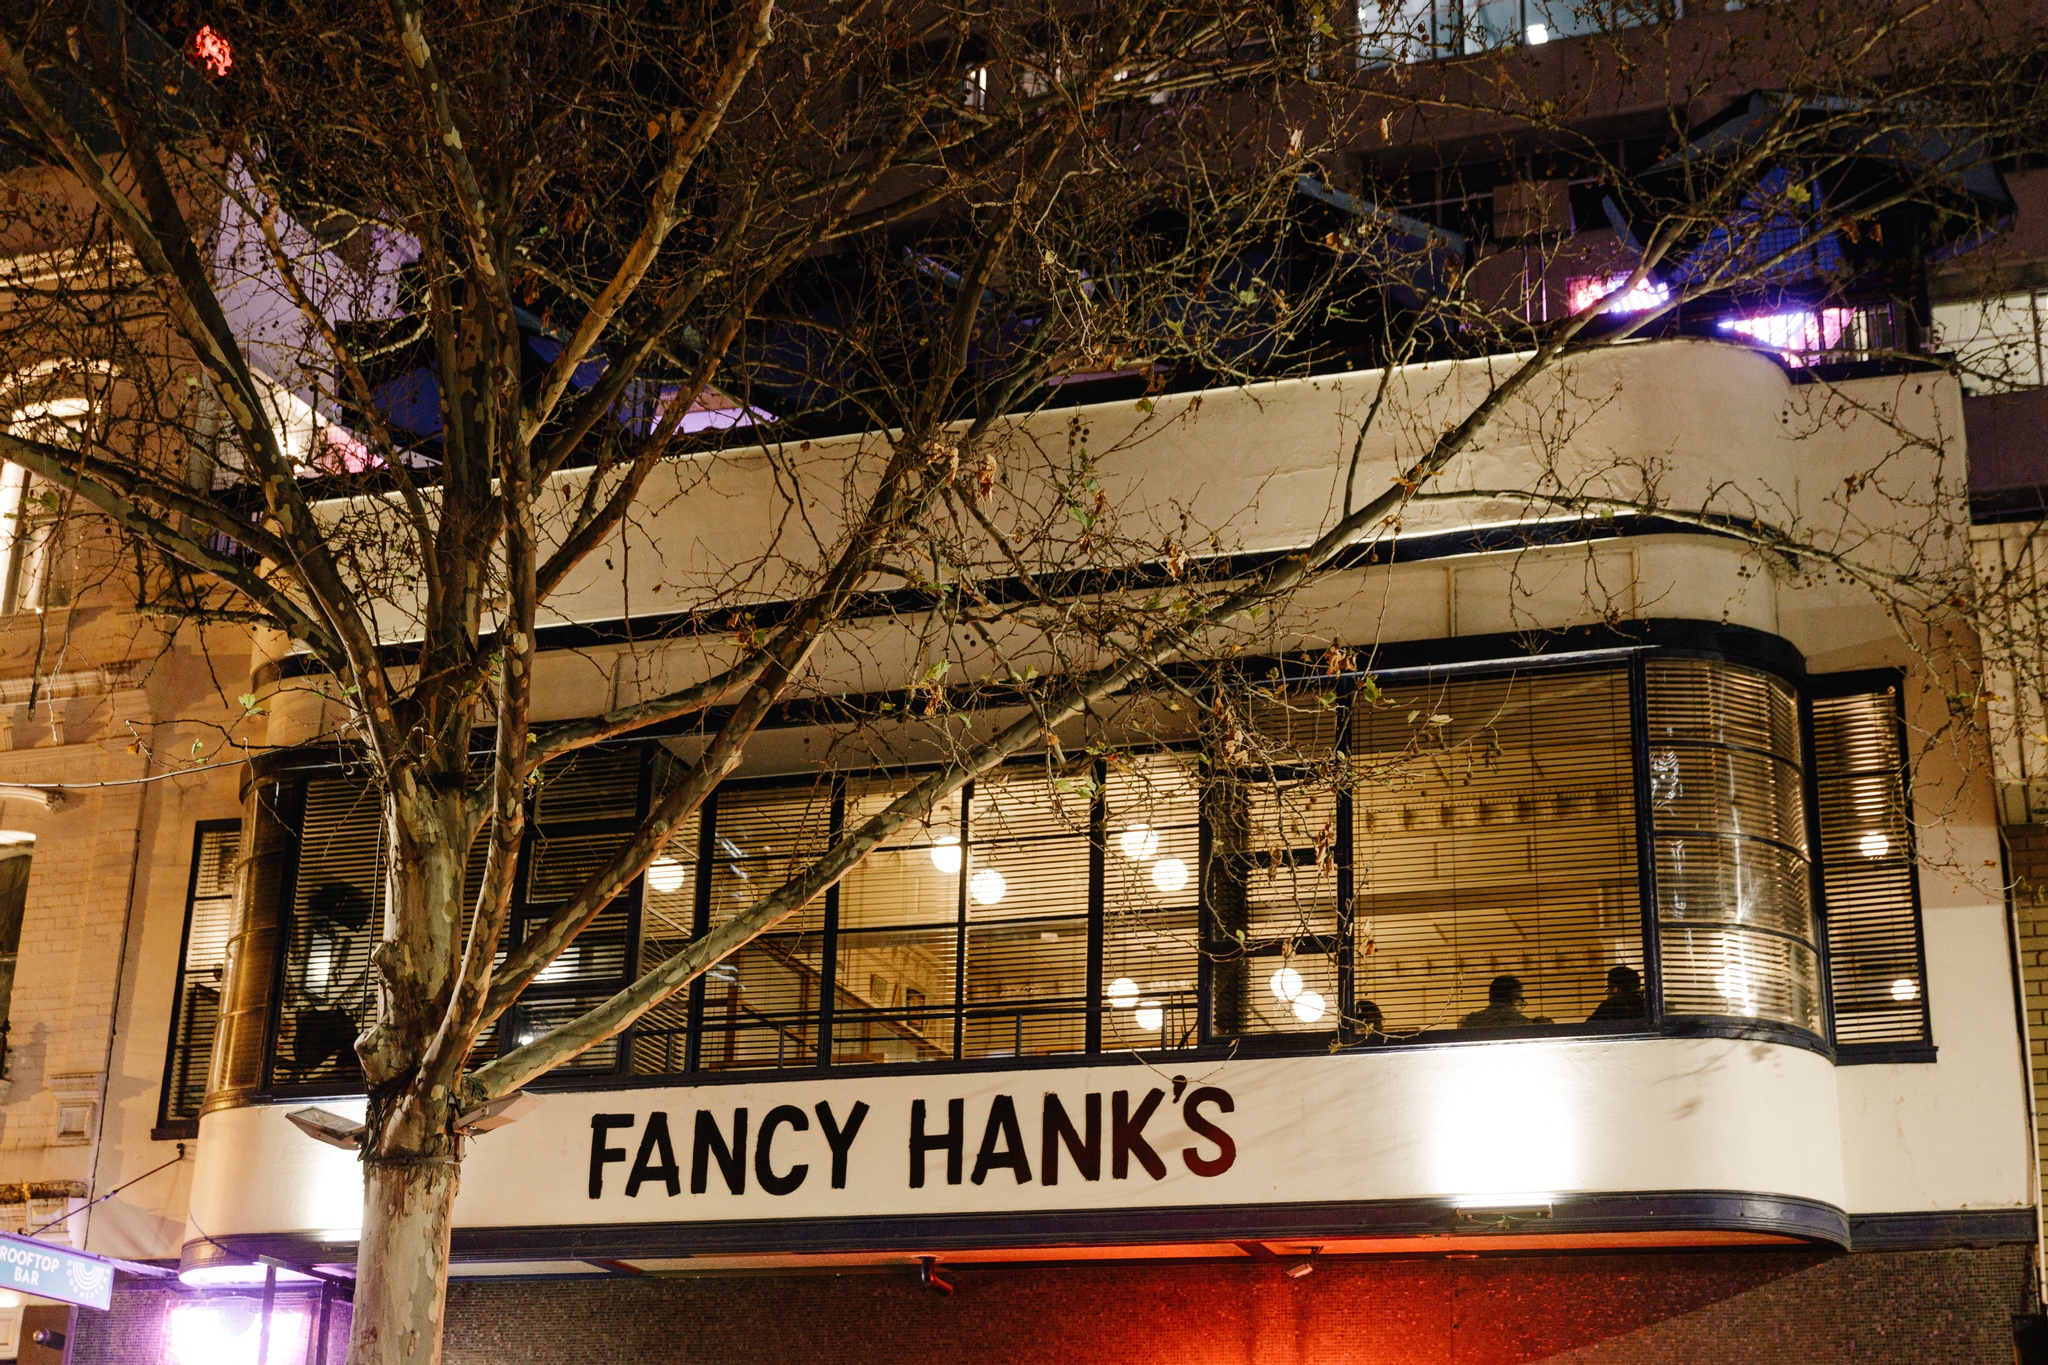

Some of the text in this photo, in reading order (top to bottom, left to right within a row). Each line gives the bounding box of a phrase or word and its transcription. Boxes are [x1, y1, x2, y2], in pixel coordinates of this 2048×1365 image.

[588, 1075, 1237, 1200] FANCY HANK'S
[0, 1245, 59, 1273] ROOFTOP
[13, 1266, 40, 1286] BAR
